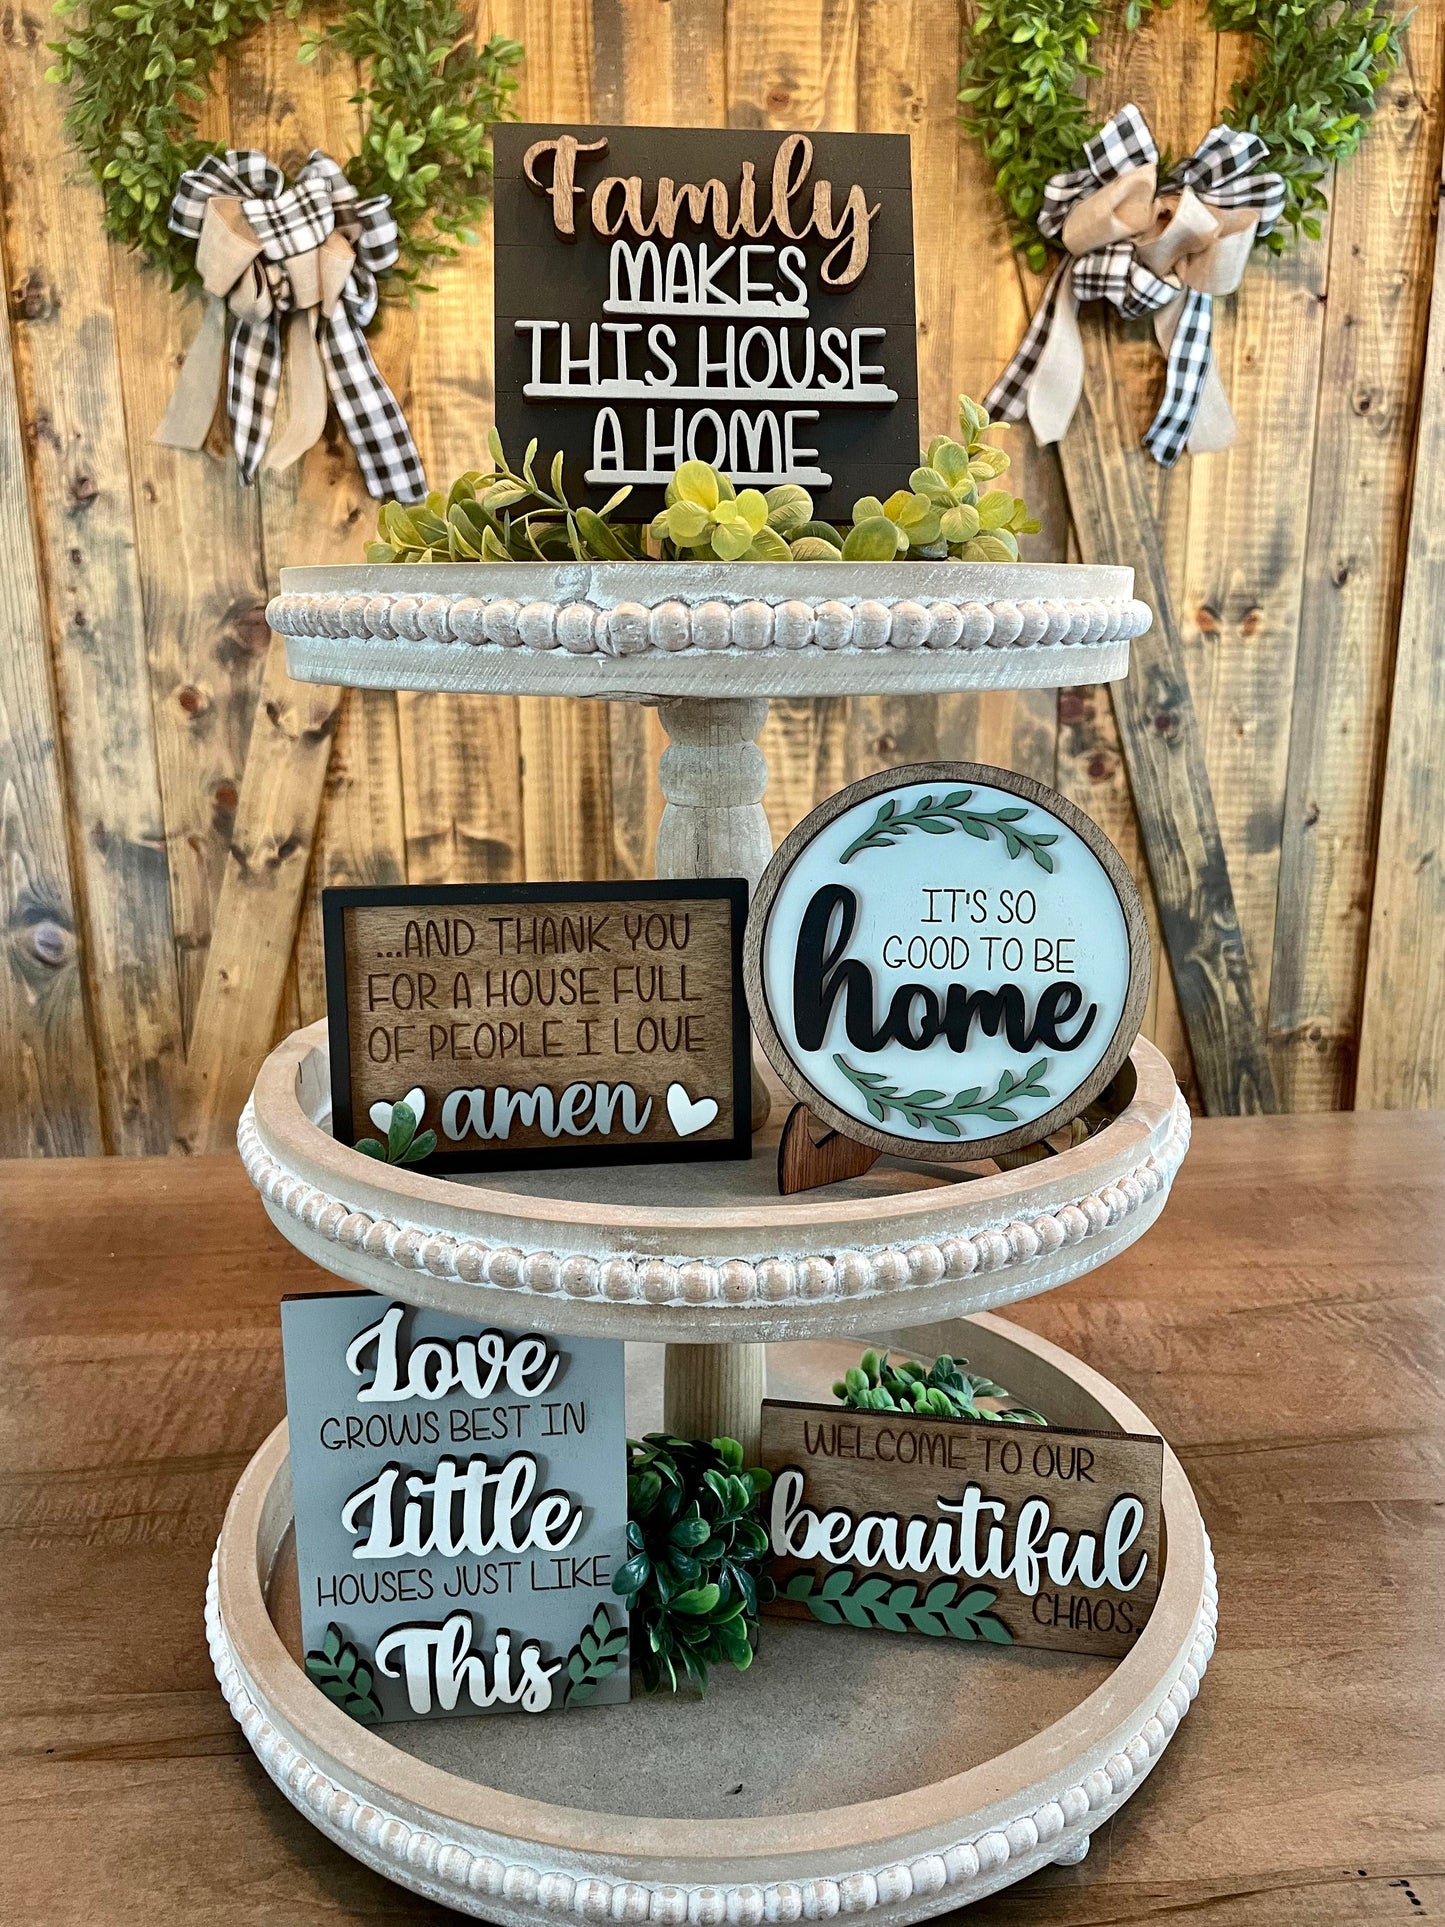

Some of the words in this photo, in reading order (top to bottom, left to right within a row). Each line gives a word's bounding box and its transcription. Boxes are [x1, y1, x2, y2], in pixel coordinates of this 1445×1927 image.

[523, 133, 882, 288] Family
[609, 240, 808, 310] MAKES
[514, 320, 678, 387] THIS
[699, 324, 887, 390] HOUSE
[593, 407, 624, 472] A
[646, 408, 820, 473] HOME
[377, 918, 476, 958] ...AND
[488, 916, 611, 955] THANK
[624, 913, 691, 952] YOU
[921, 888, 987, 923] IT'S
[997, 889, 1037, 925] SO
[793, 883, 1098, 1054] home
[882, 935, 970, 970] GOOD
[979, 936, 1023, 972] TO
[1034, 938, 1076, 974] BE
[368, 971, 438, 1012] FOR
[453, 970, 472, 1009] A
[486, 967, 600, 1007] HOUSE
[613, 965, 702, 1005] FULL
[368, 1025, 415, 1063] OF
[429, 1020, 563, 1061] PEOPLE
[576, 1018, 602, 1055] I
[614, 1014, 706, 1054] LOVE
[441, 1082, 652, 1141] amen
[345, 1303, 560, 1402] Love
[320, 1410, 440, 1450] GROWS
[449, 1405, 531, 1442] BEST
[541, 1401, 586, 1436] IN
[804, 1420, 967, 1470] WELCOME
[977, 1437, 1024, 1475] TO
[1032, 1443, 1096, 1483] OUR
[341, 1451, 583, 1560] Little
[771, 1468, 1148, 1597] beautiful
[317, 1568, 434, 1607] HOUSES
[443, 1561, 521, 1597] JUST
[530, 1554, 613, 1592] LIKE
[375, 1610, 562, 1714] This
